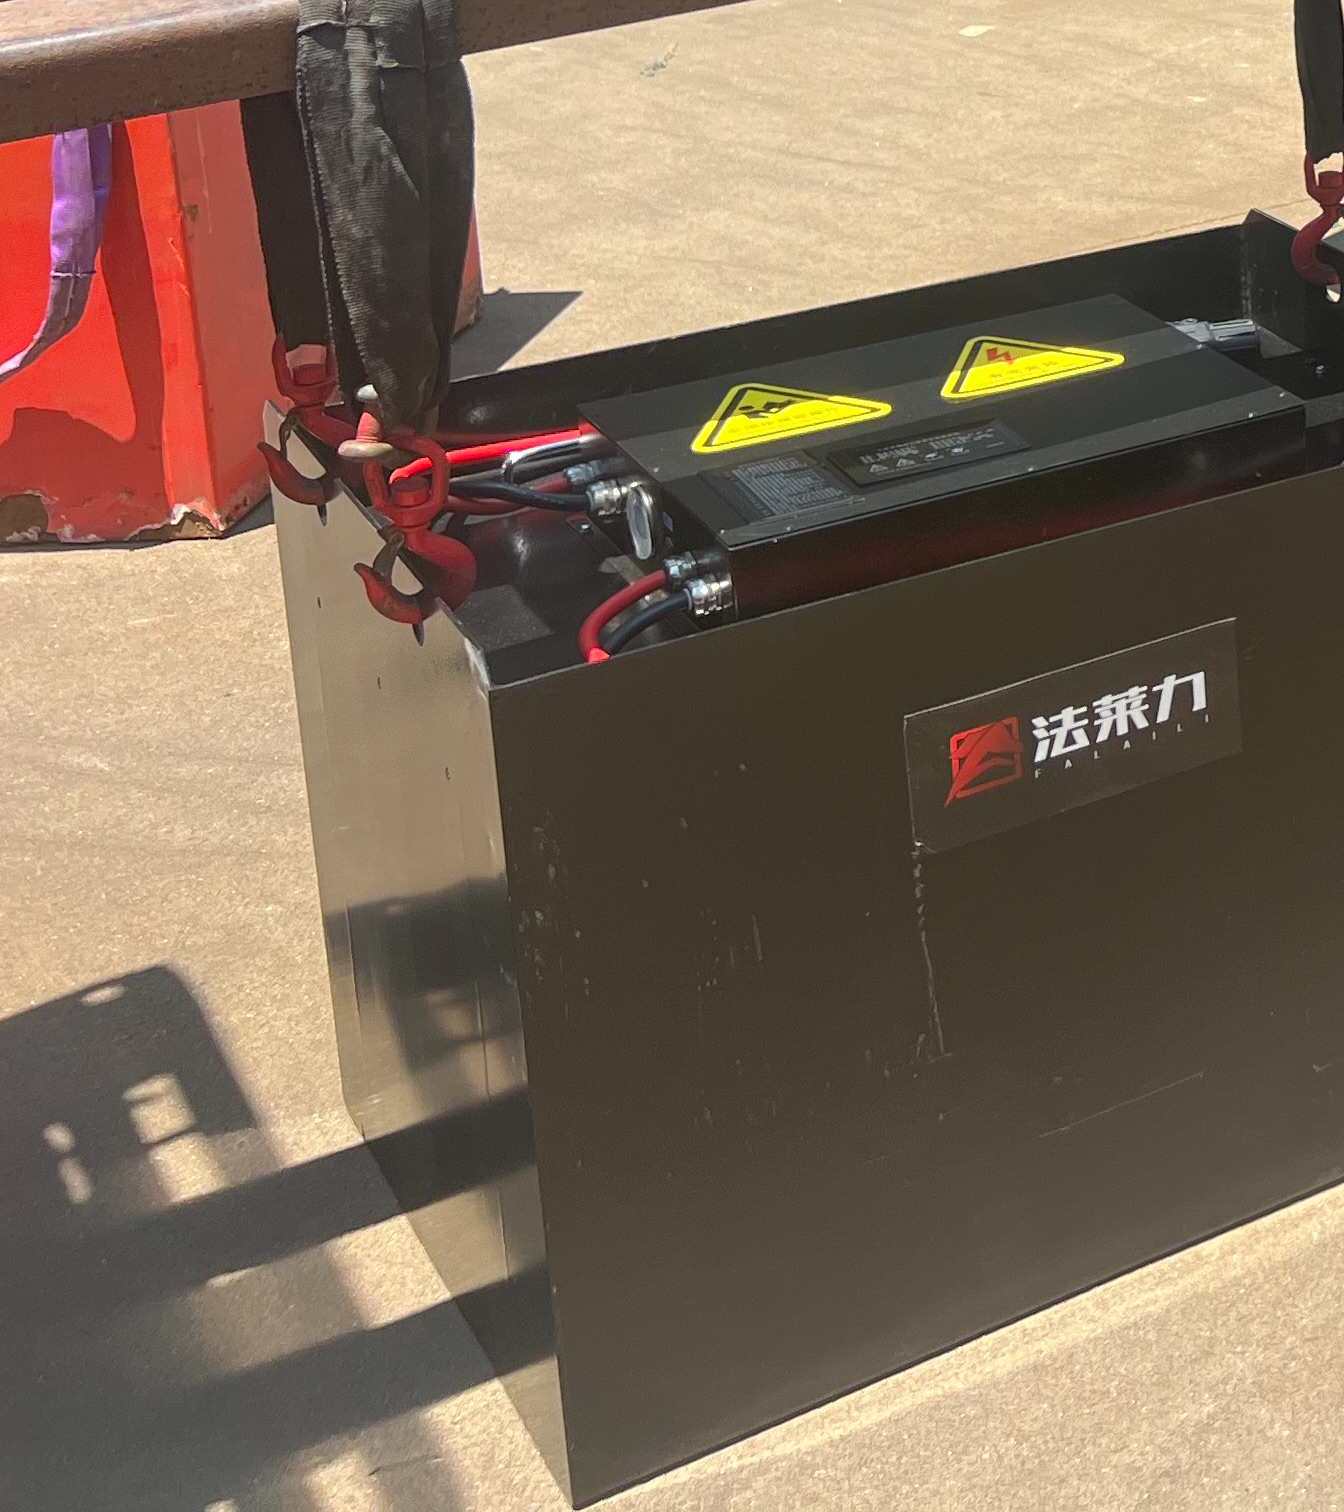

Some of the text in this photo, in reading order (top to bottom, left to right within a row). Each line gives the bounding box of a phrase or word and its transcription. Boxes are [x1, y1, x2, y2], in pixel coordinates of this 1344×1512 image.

[1031, 671, 1208, 763] 法莱力
[1034, 713, 1209, 779] FALAILI
